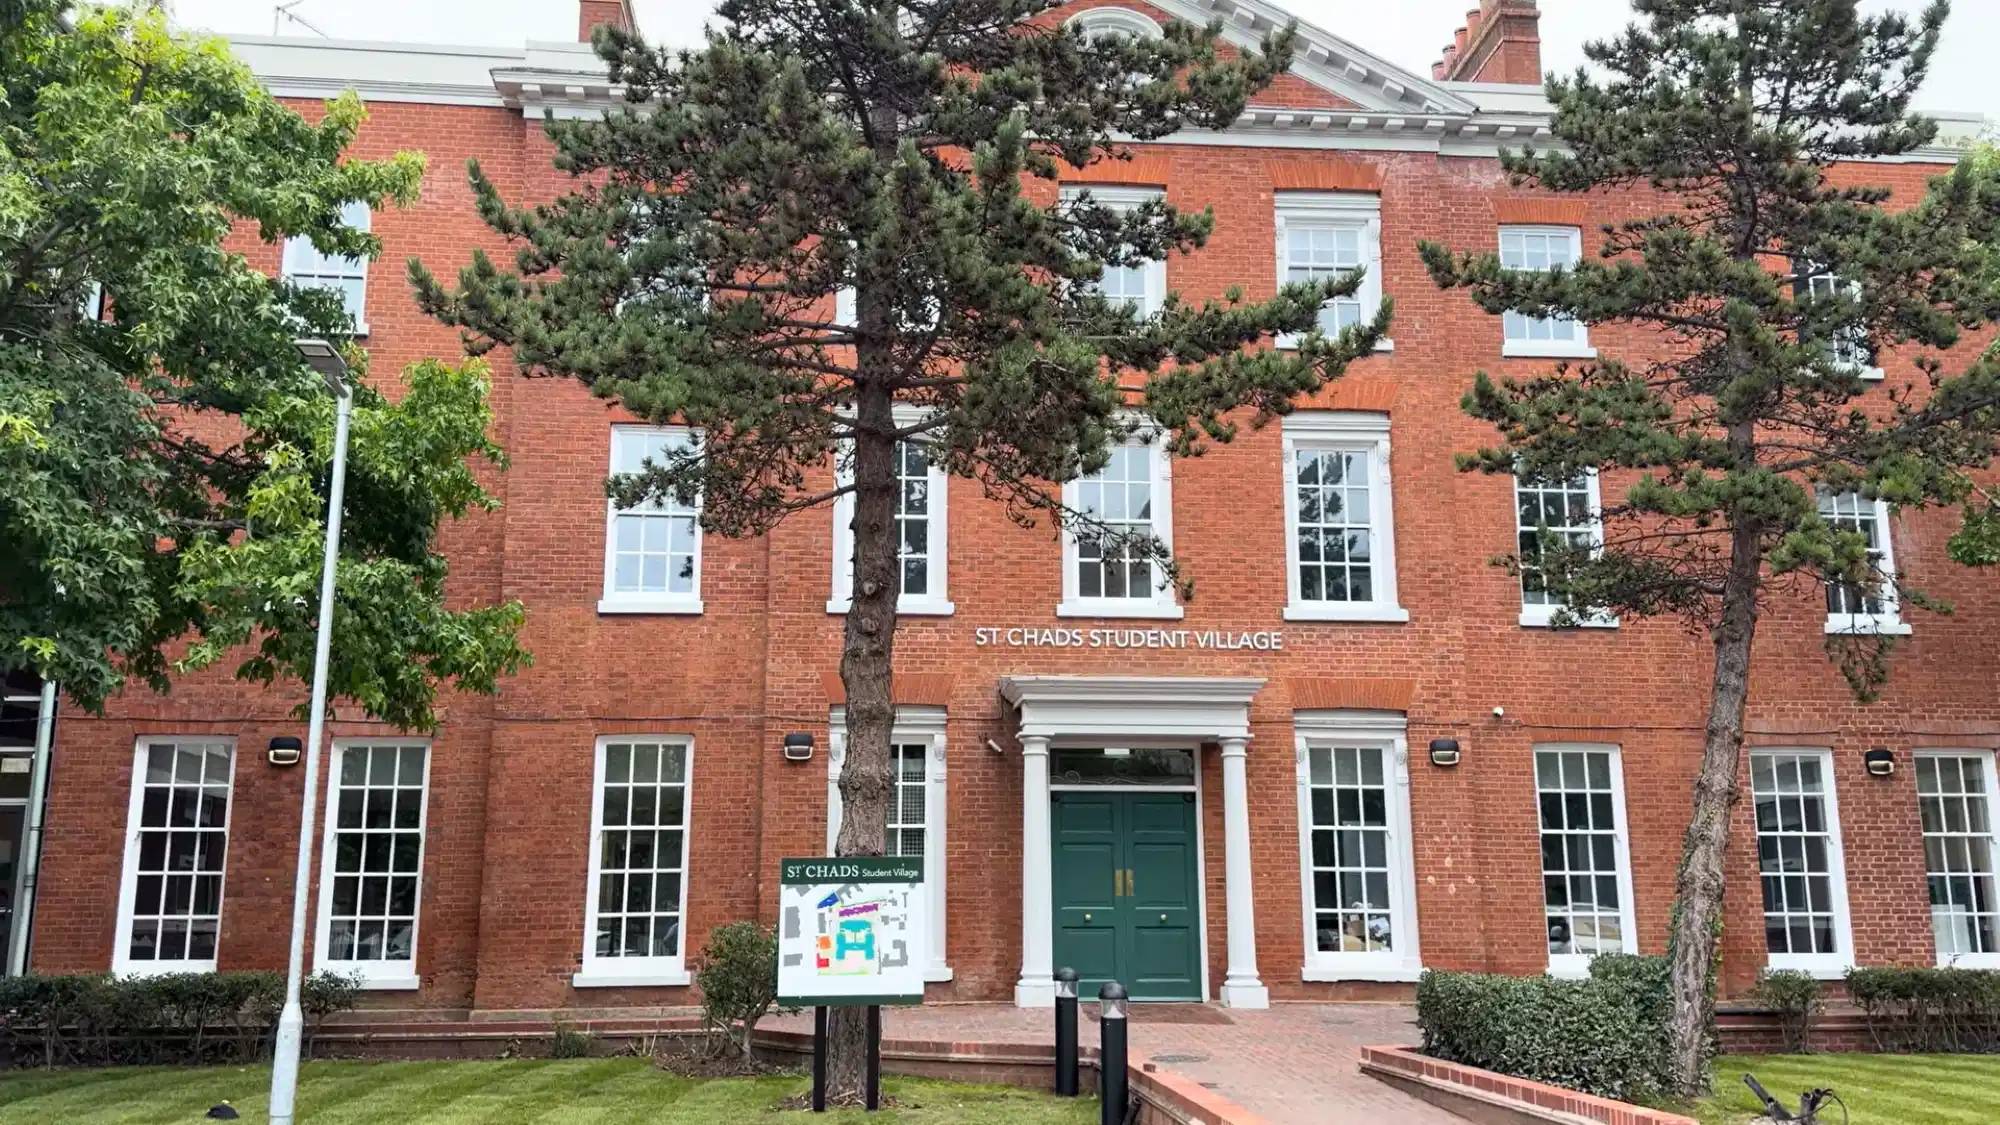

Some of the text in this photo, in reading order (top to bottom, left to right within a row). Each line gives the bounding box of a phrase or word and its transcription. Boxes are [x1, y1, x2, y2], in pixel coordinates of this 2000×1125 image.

[975, 627, 1283, 650] ST CHADS STUDENT VILLAGE
[805, 864, 859, 878] CHADS
[862, 868, 892, 877] Student
[893, 868, 919, 879] Village
